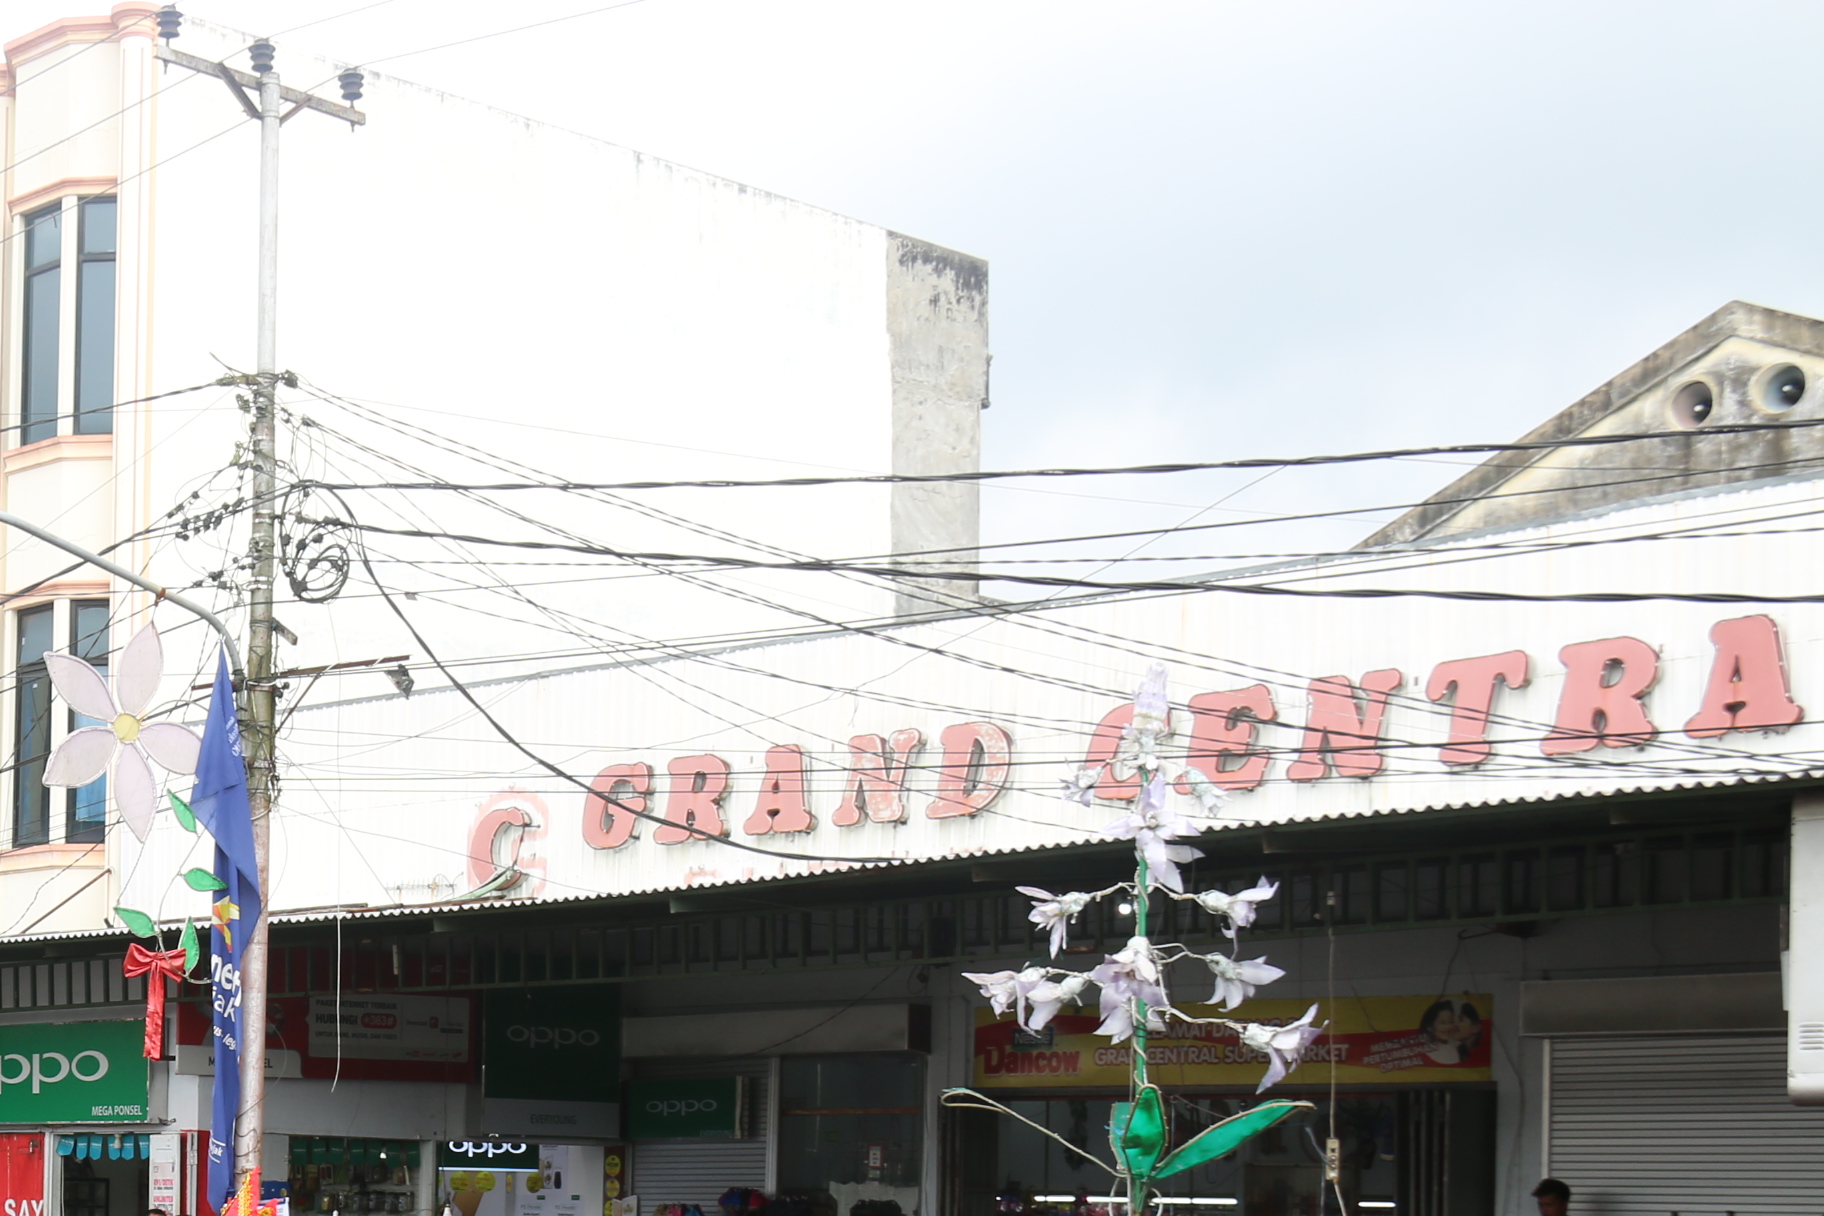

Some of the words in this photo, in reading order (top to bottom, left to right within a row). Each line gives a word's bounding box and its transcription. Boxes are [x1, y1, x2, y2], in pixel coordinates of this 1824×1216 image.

[581, 721, 1015, 851] GRAND
[506, 1024, 601, 1049] oppo
[1146, 1045, 1221, 1065] CENTRAL
[1379, 1056, 1424, 1073] OPTIMAL
[91, 1106, 114, 1116] MEGA
[114, 1105, 143, 1116] PONSEL
[645, 1099, 718, 1116] oppo
